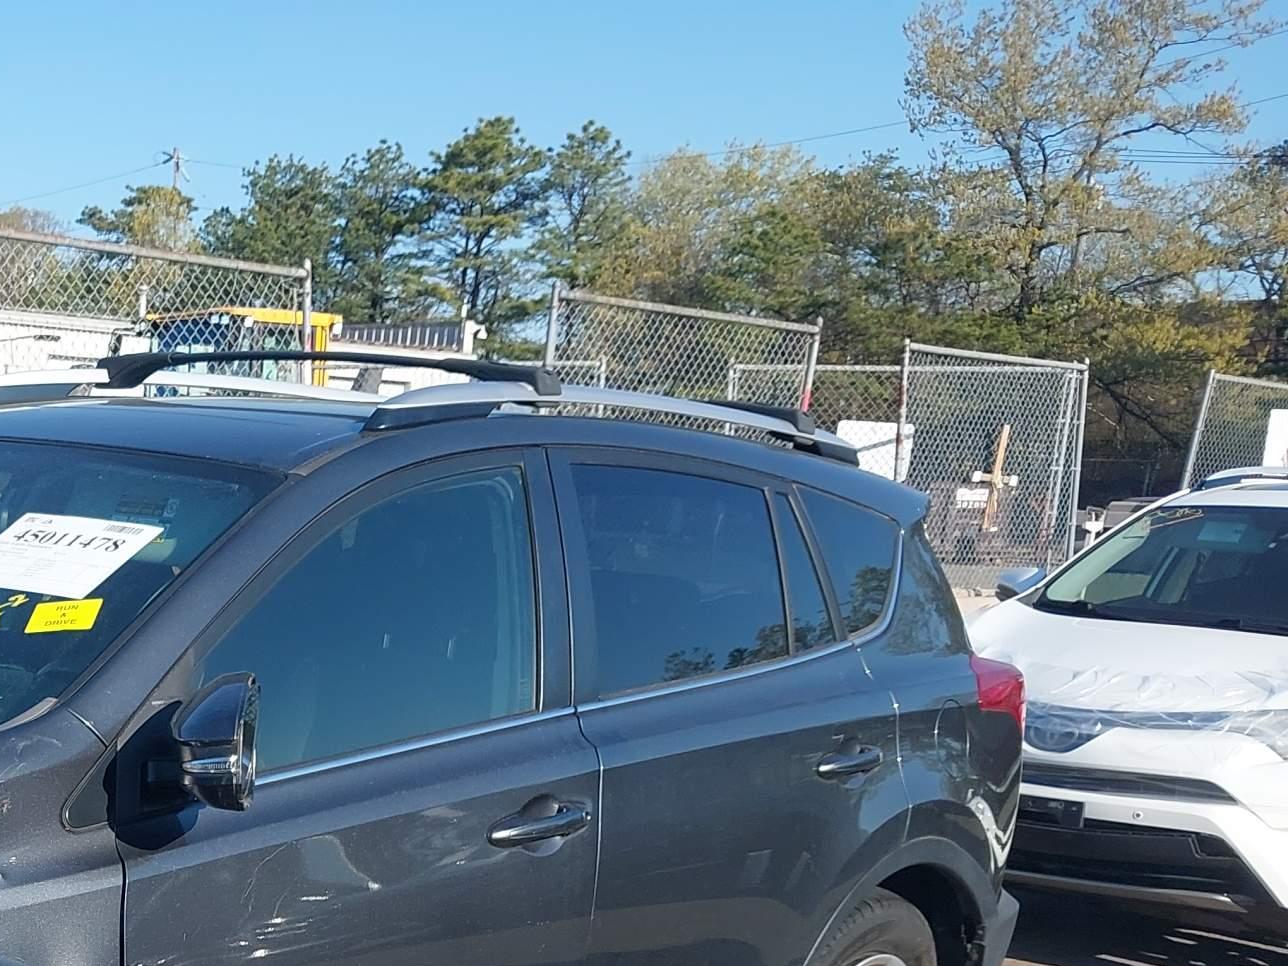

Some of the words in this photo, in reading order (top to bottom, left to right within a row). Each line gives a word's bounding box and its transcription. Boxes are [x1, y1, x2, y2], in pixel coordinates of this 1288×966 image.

[13, 528, 126, 553] 45011478
[55, 604, 79, 612] RUN
[44, 618, 78, 627] DRIVE
